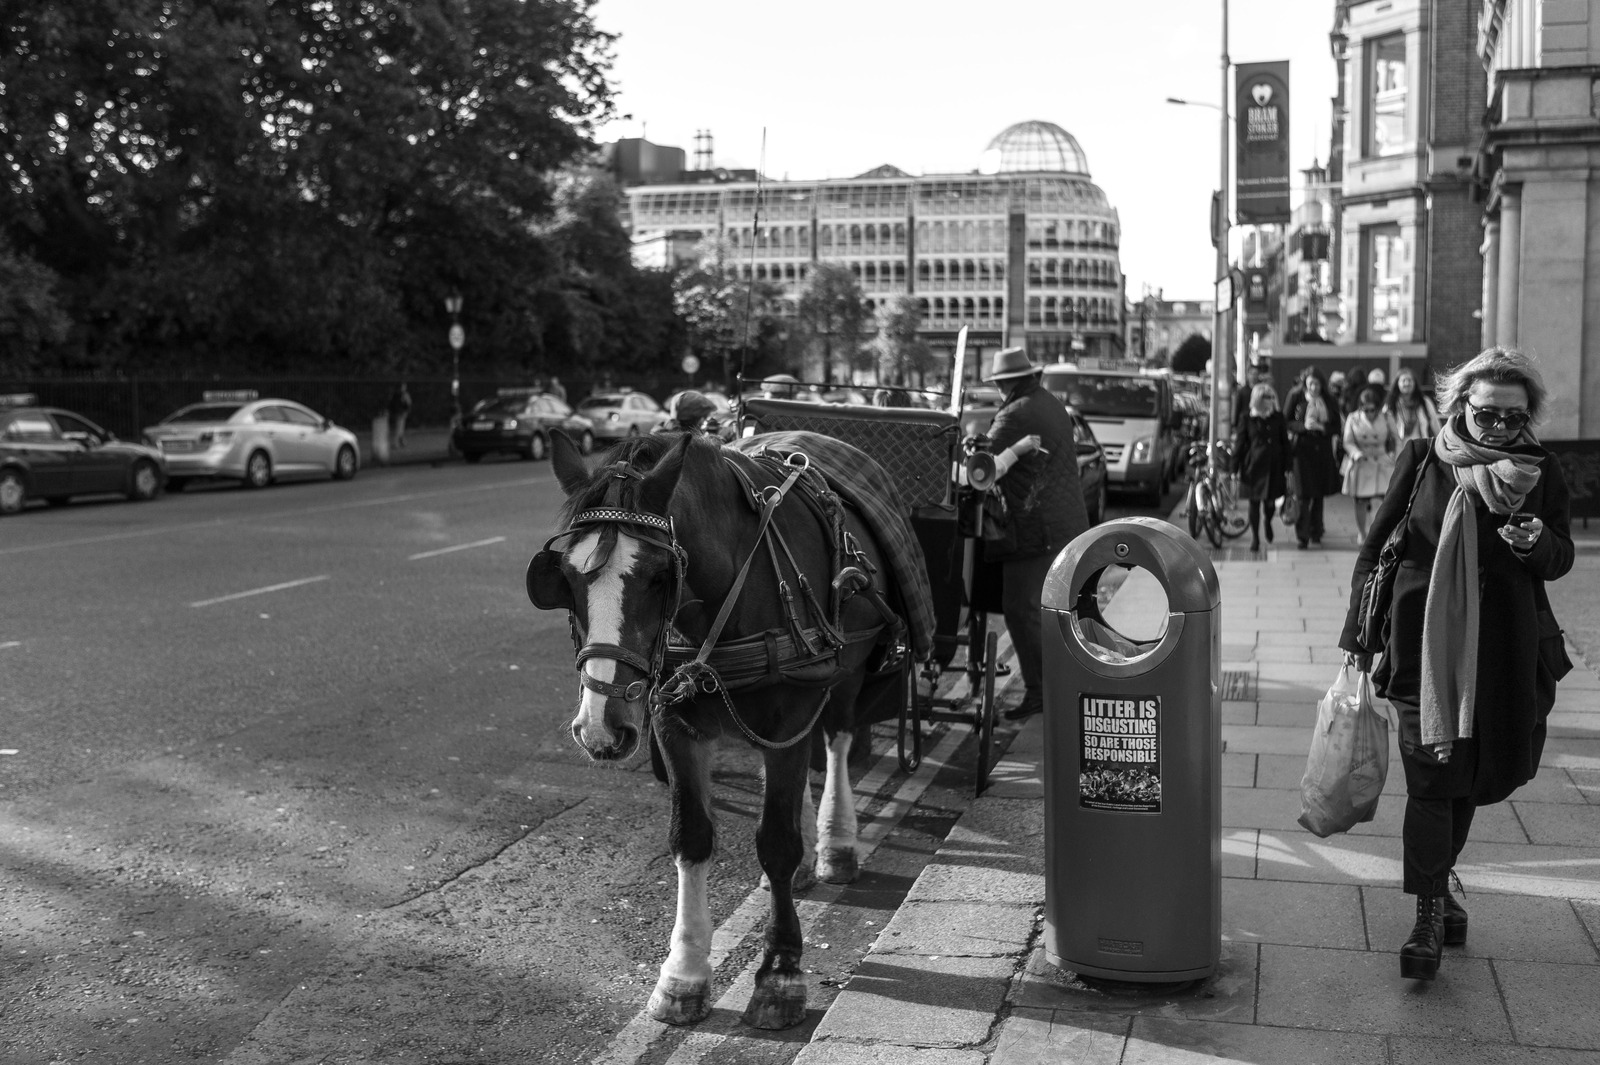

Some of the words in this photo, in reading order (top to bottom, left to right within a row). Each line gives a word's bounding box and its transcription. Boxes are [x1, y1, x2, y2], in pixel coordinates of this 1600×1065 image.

[1248, 106, 1278, 122] BRAM
[1083, 698, 1136, 718] LITTER
[1139, 700, 1157, 719] IS
[1084, 716, 1157, 734] DISGUSTING
[1084, 735, 1098, 747] SO
[1099, 737, 1120, 749] ARE
[1121, 738, 1157, 750] THOSE
[1084, 747, 1157, 763] RESPONSIBLE
